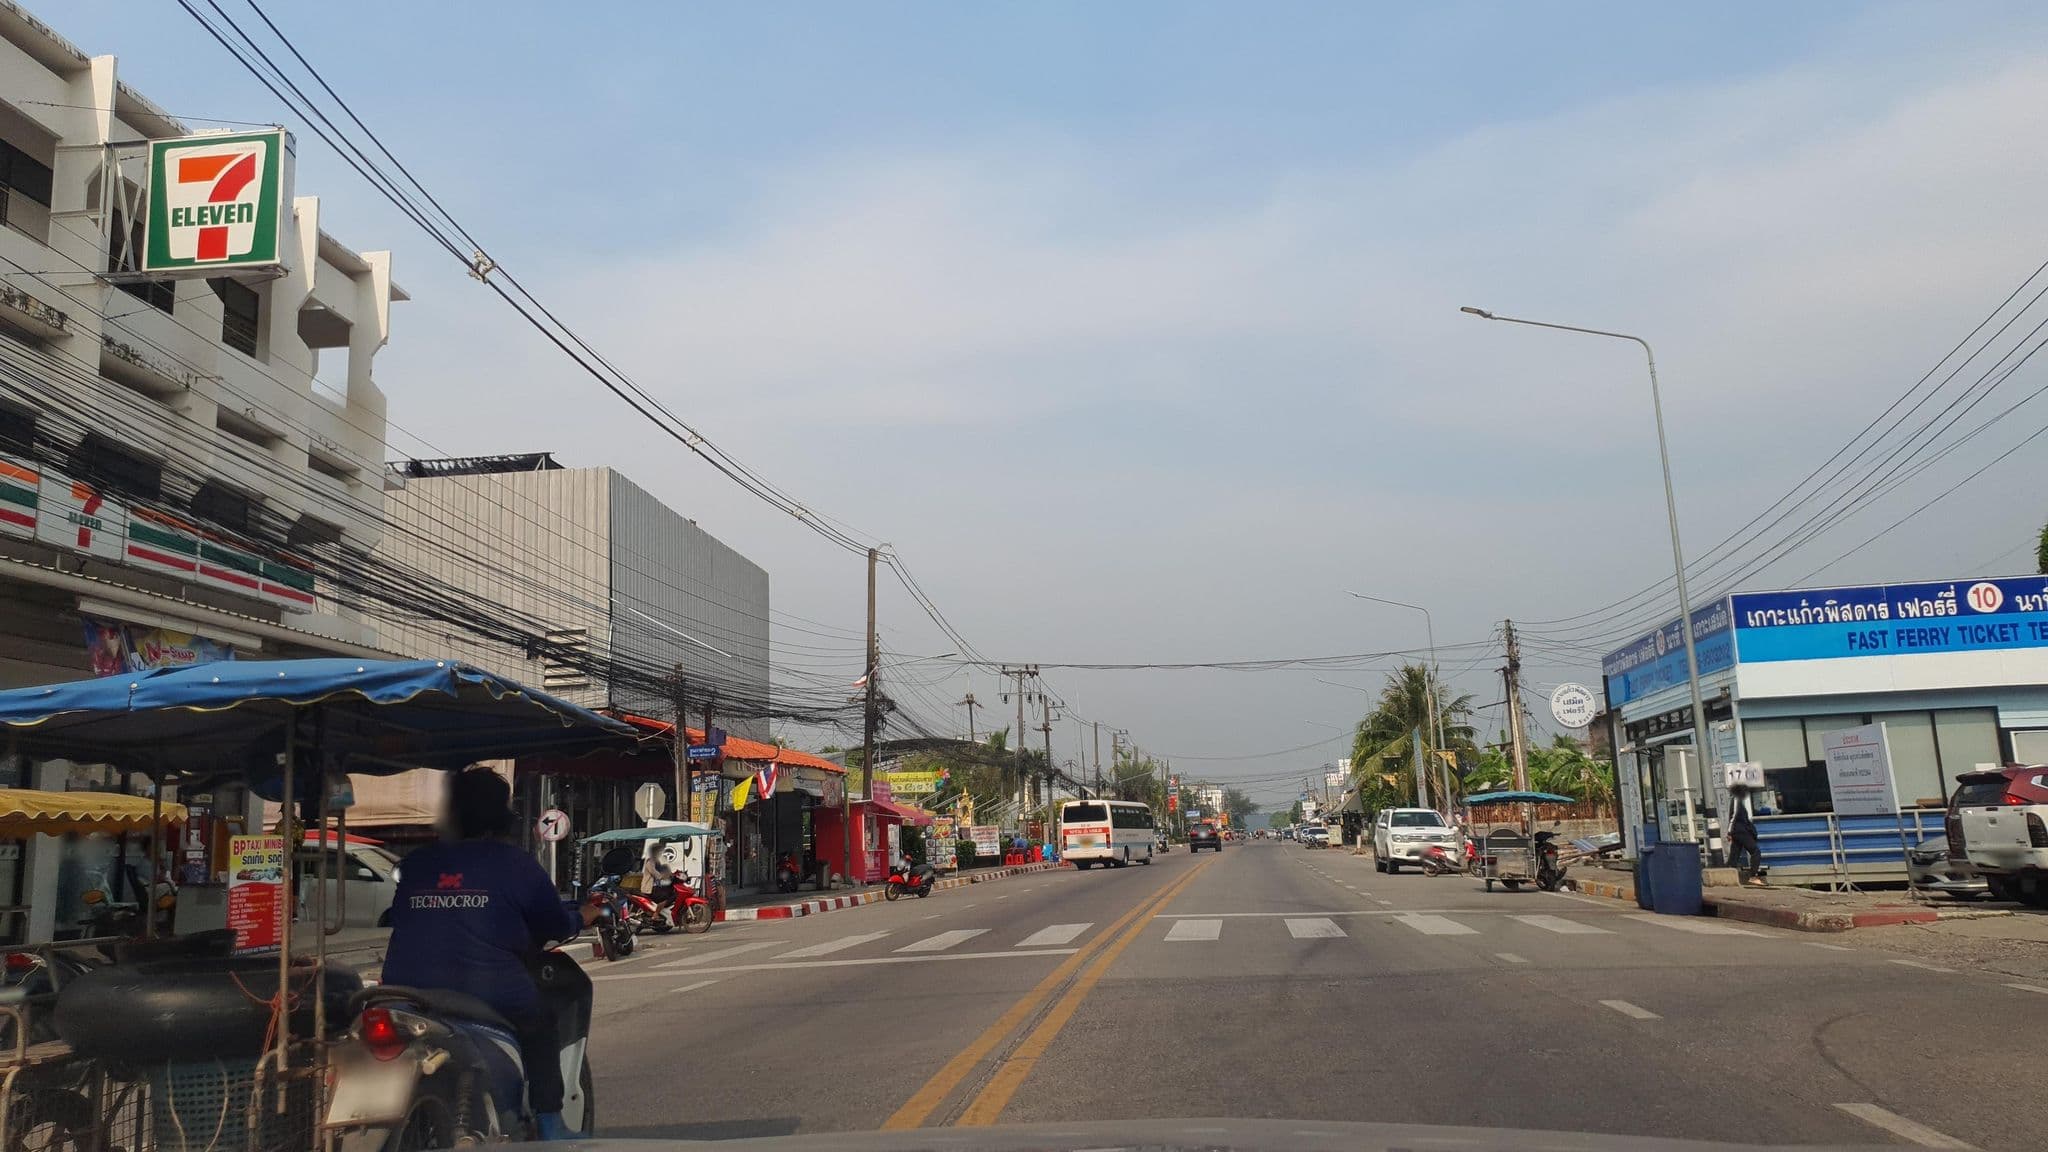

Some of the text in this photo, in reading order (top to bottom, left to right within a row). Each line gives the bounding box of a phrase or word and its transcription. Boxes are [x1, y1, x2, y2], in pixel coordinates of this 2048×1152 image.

[1746, 599, 1889, 627] เกาะแก้วพิสดาร
[1972, 586, 1997, 610] 10
[1847, 630, 1889, 651] FAST
[1896, 626, 1950, 648] FERRY
[1957, 622, 2020, 646] TICKET
[233, 840, 245, 856] BP
[247, 839, 261, 850] TAXI
[409, 895, 489, 908] TECHNOCROP
